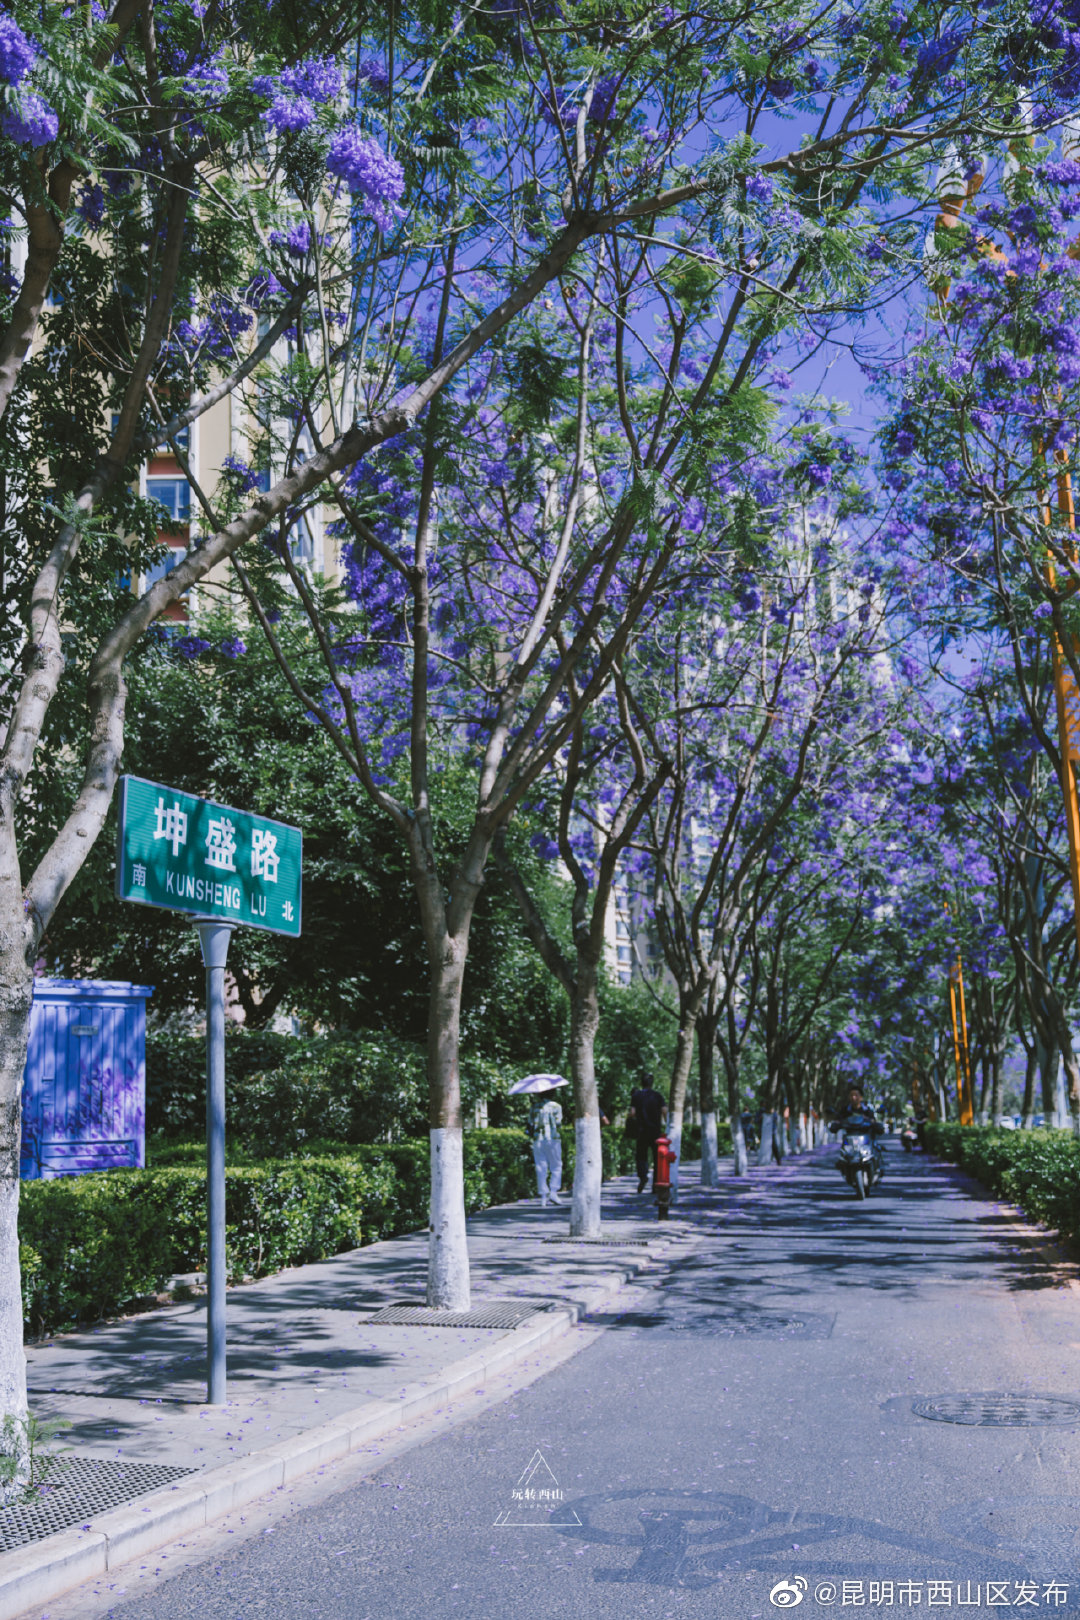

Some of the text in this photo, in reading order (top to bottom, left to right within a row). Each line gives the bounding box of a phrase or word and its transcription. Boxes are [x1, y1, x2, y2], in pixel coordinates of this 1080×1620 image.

[153, 797, 280, 883] 坤盛路
[132, 863, 147, 887] 南
[166, 870, 267, 917] KUNSHENG LU
[282, 900, 294, 922] 北
